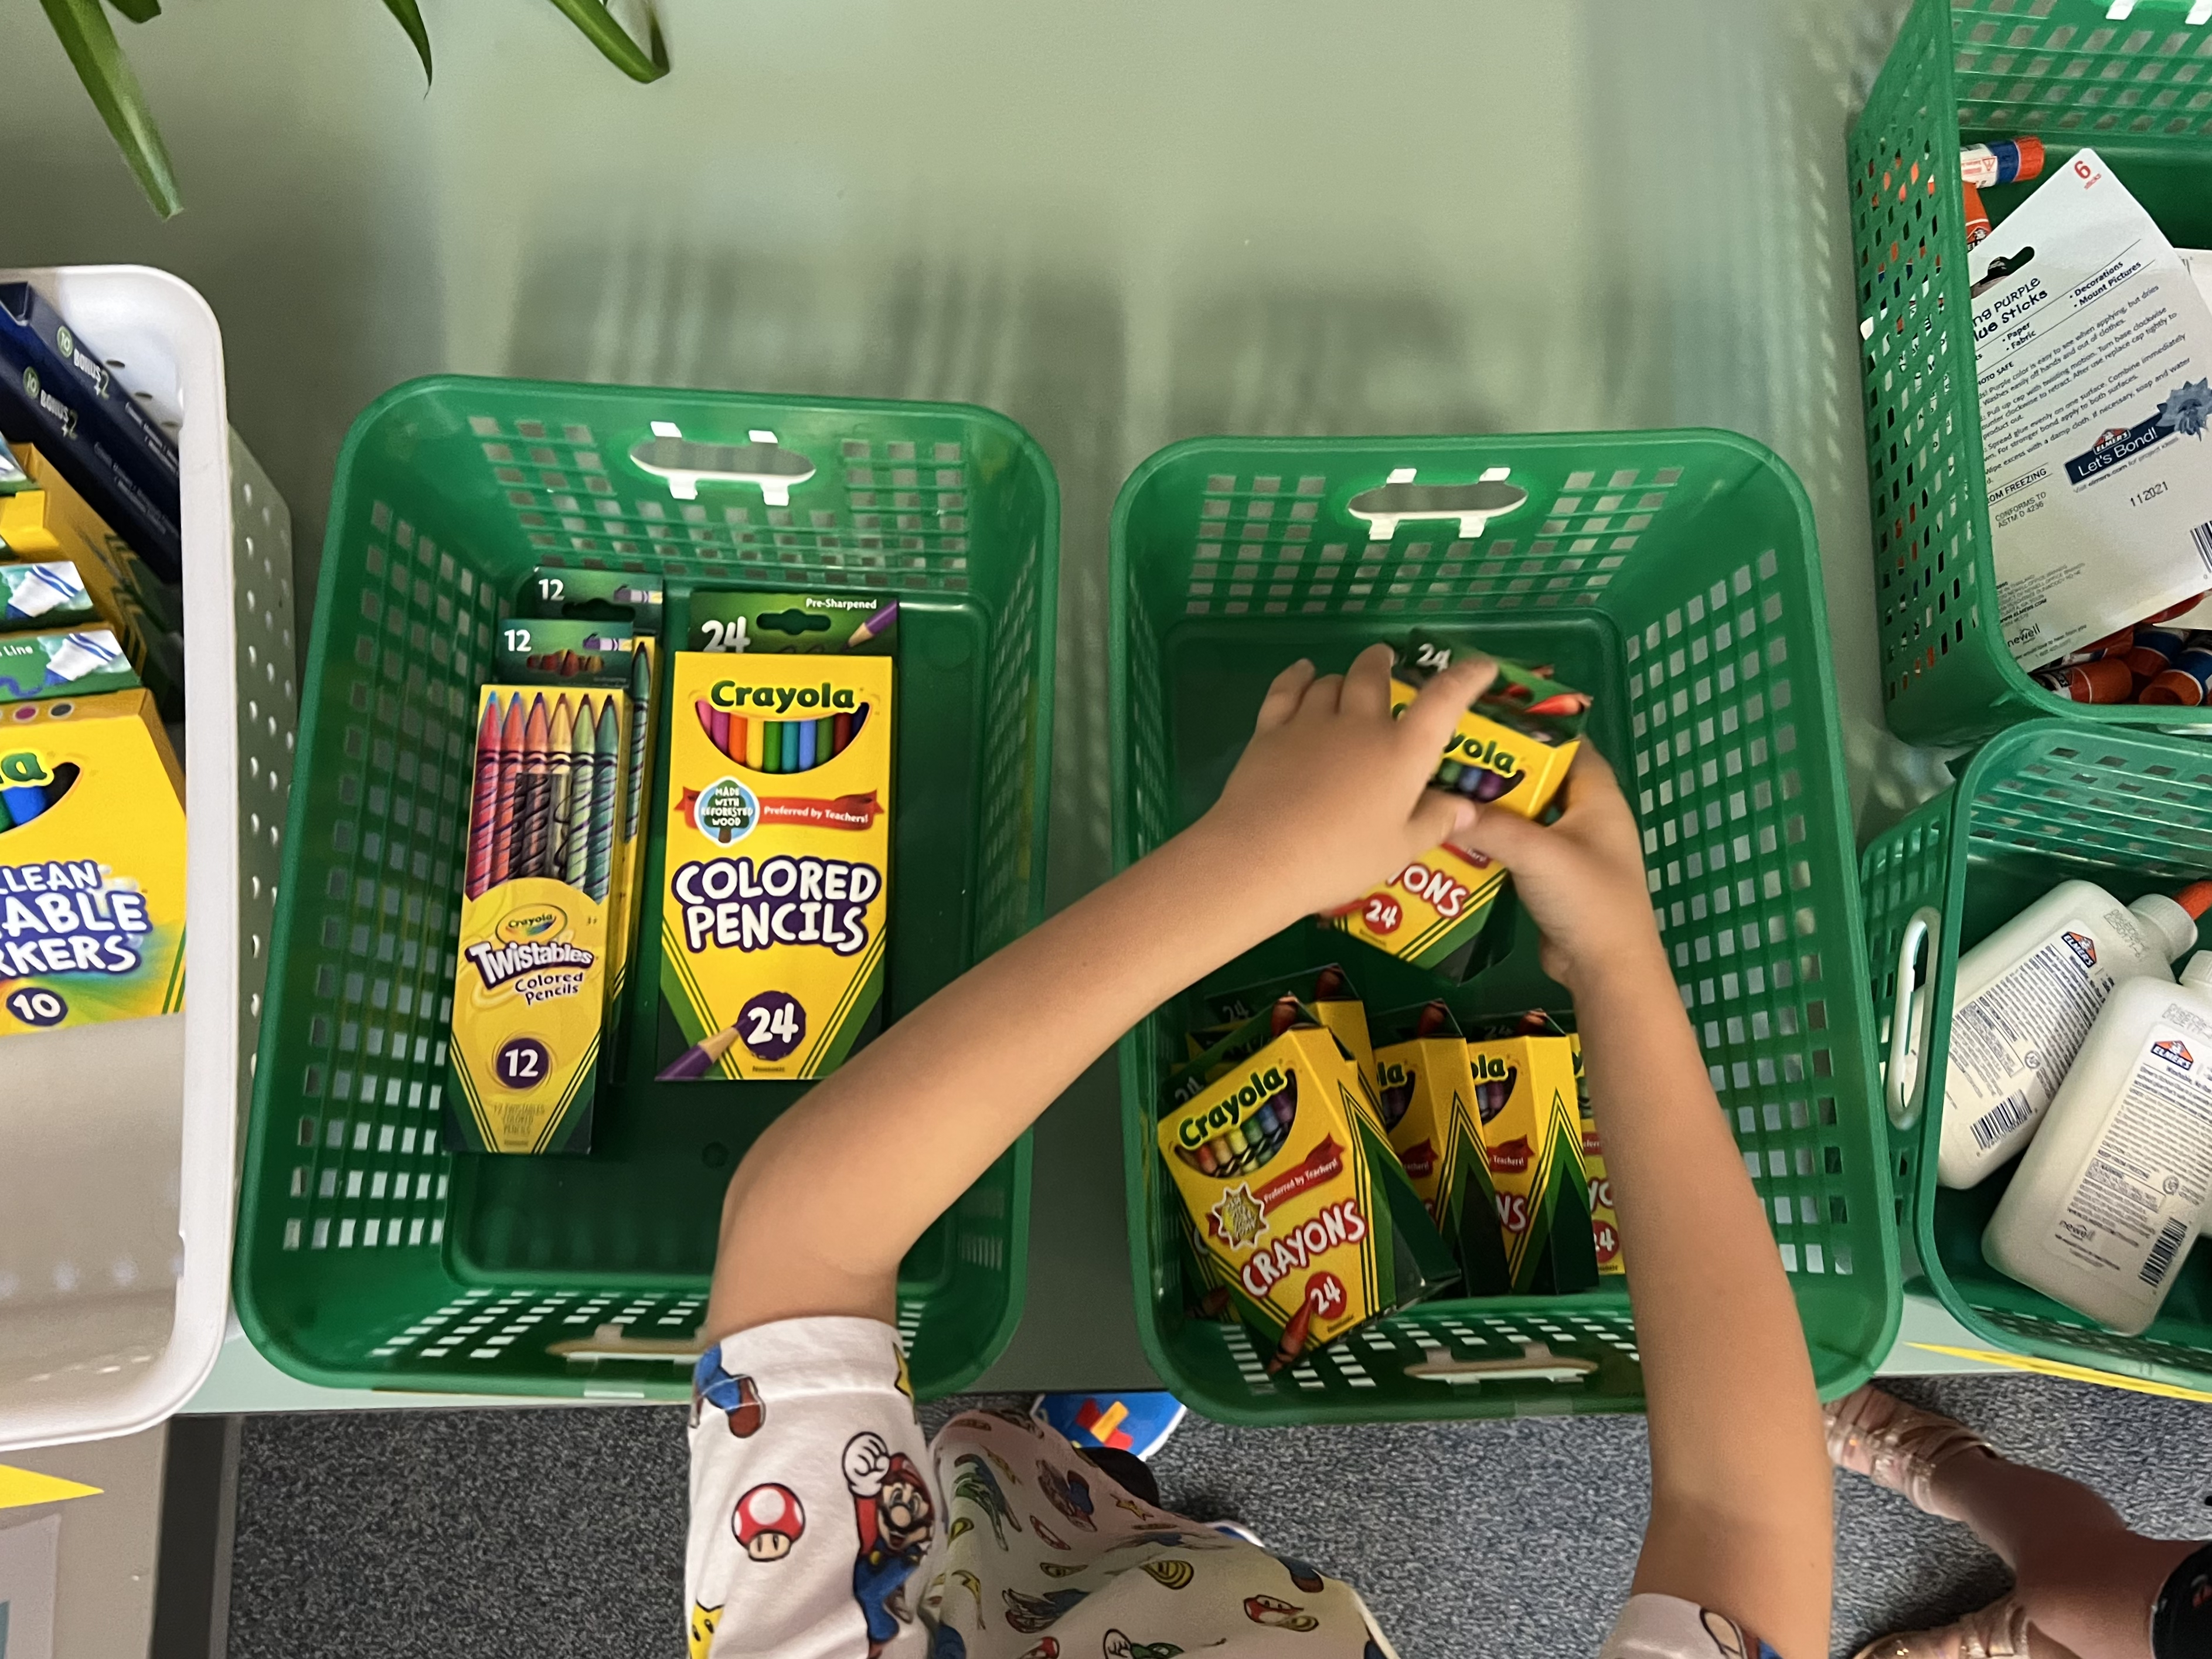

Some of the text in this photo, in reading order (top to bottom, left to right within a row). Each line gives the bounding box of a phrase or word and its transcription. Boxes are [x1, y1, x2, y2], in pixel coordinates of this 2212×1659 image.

[2074, 160, 2091, 179] 6
[1993, 277, 2041, 312] PURPLE
[2073, 261, 2123, 297] Decorations
[2078, 261, 2142, 306] Mount Pictures
[2000, 290, 2048, 324] Sticks
[1988, 378, 2011, 393] Purple
[2012, 366, 2029, 380] color
[2036, 352, 2053, 365] easy
[2052, 347, 2061, 355] to
[2061, 339, 2074, 349] see
[2074, 325, 2095, 341] when
[2126, 295, 2141, 308] but
[2140, 284, 2159, 300] dries
[2006, 321, 2030, 341] Paper
[2010, 329, 2037, 349] Fabric
[1982, 389, 2009, 406] Washes
[2029, 369, 2040, 380] off
[2039, 357, 2062, 373] hands
[2062, 346, 2077, 360] and
[2076, 339, 2090, 351] out
[2089, 332, 2098, 343] of
[1986, 405, 2001, 418] Pull
[2000, 401, 2012, 410] up
[2012, 393, 2025, 404] cap
[2025, 384, 2042, 396] with
[2041, 367, 2070, 387] twisting
[2097, 340, 2115, 352] Turn
[2113, 329, 2132, 343] base
[2132, 307, 2167, 331] clockwise
[1995, 361, 2014, 376] SAFE
[2004, 396, 2039, 417] clockwise
[2038, 391, 2047, 399] to
[2072, 365, 2089, 379] After
[2090, 357, 2104, 368] use
[2104, 341, 2131, 360] replace
[2131, 332, 2145, 344] cap
[2144, 317, 2167, 335] tightly
[2167, 312, 2177, 320] to
[1987, 432, 2013, 450] Spread
[2013, 424, 2029, 438] glue
[2029, 412, 2053, 428] evenly
[2053, 406, 2064, 415] on
[2064, 397, 2079, 409] one
[2107, 361, 2140, 383] Combine
[2140, 332, 2186, 363] immediately
[1996, 445, 2009, 455] For
[2009, 429, 2039, 448] stronger
[2039, 418, 2059, 433] bond
[2060, 407, 2080, 422] apply
[2079, 402, 2088, 410] to
[2088, 392, 2106, 405] both
[2002, 450, 2026, 465] excess
[2026, 441, 2043, 453] with
[2049, 427, 2071, 441] damp
[2135, 379, 2153, 393] soap
[2154, 369, 2169, 382] and
[2168, 357, 2190, 373] water
[1982, 421, 2009, 441] product
[2077, 426, 2157, 477] Let's Bond!
[2003, 467, 2047, 495] FREEZING
[1994, 491, 2047, 522] CONFORMS TO
[1997, 513, 2018, 529] ASTM
[2026, 500, 2044, 513] 4236
[539, 579, 565, 601] 12
[806, 598, 876, 610] Pre-Sharpened
[504, 628, 532, 652] 12
[702, 616, 751, 652] 24
[2006, 622, 2041, 647] newell
[1417, 642, 1451, 671] 24
[711, 680, 856, 713] Crayola
[714, 798, 740, 807] WITH
[715, 786, 740, 796] MADE
[701, 807, 754, 817] REFORESTED
[712, 818, 741, 827] WOOD
[764, 805, 869, 824] Preferred by Teachers!
[0, 861, 97, 895] LEAN
[675, 859, 877, 905] COLORED
[0, 892, 147, 937] ABLE
[508, 913, 553, 929] Crayola
[686, 901, 865, 953] PENCILS
[1366, 900, 1400, 929] 24
[469, 941, 594, 984] Twistables
[2063, 934, 2094, 966] ELMER'S
[515, 971, 584, 992] Colored
[13, 992, 61, 1021] 10
[746, 1002, 799, 1045] 24
[505, 1048, 539, 1078] 12
[2152, 1045, 2191, 1069] ELMER'S
[1179, 1068, 1291, 1152] Crayola
[1493, 1154, 1524, 1167] Teachers!
[1261, 1155, 1340, 1204] Preferred by Teachers!
[1243, 1201, 1365, 1295] CRAYONS
[1309, 1278, 1340, 1314] 24
